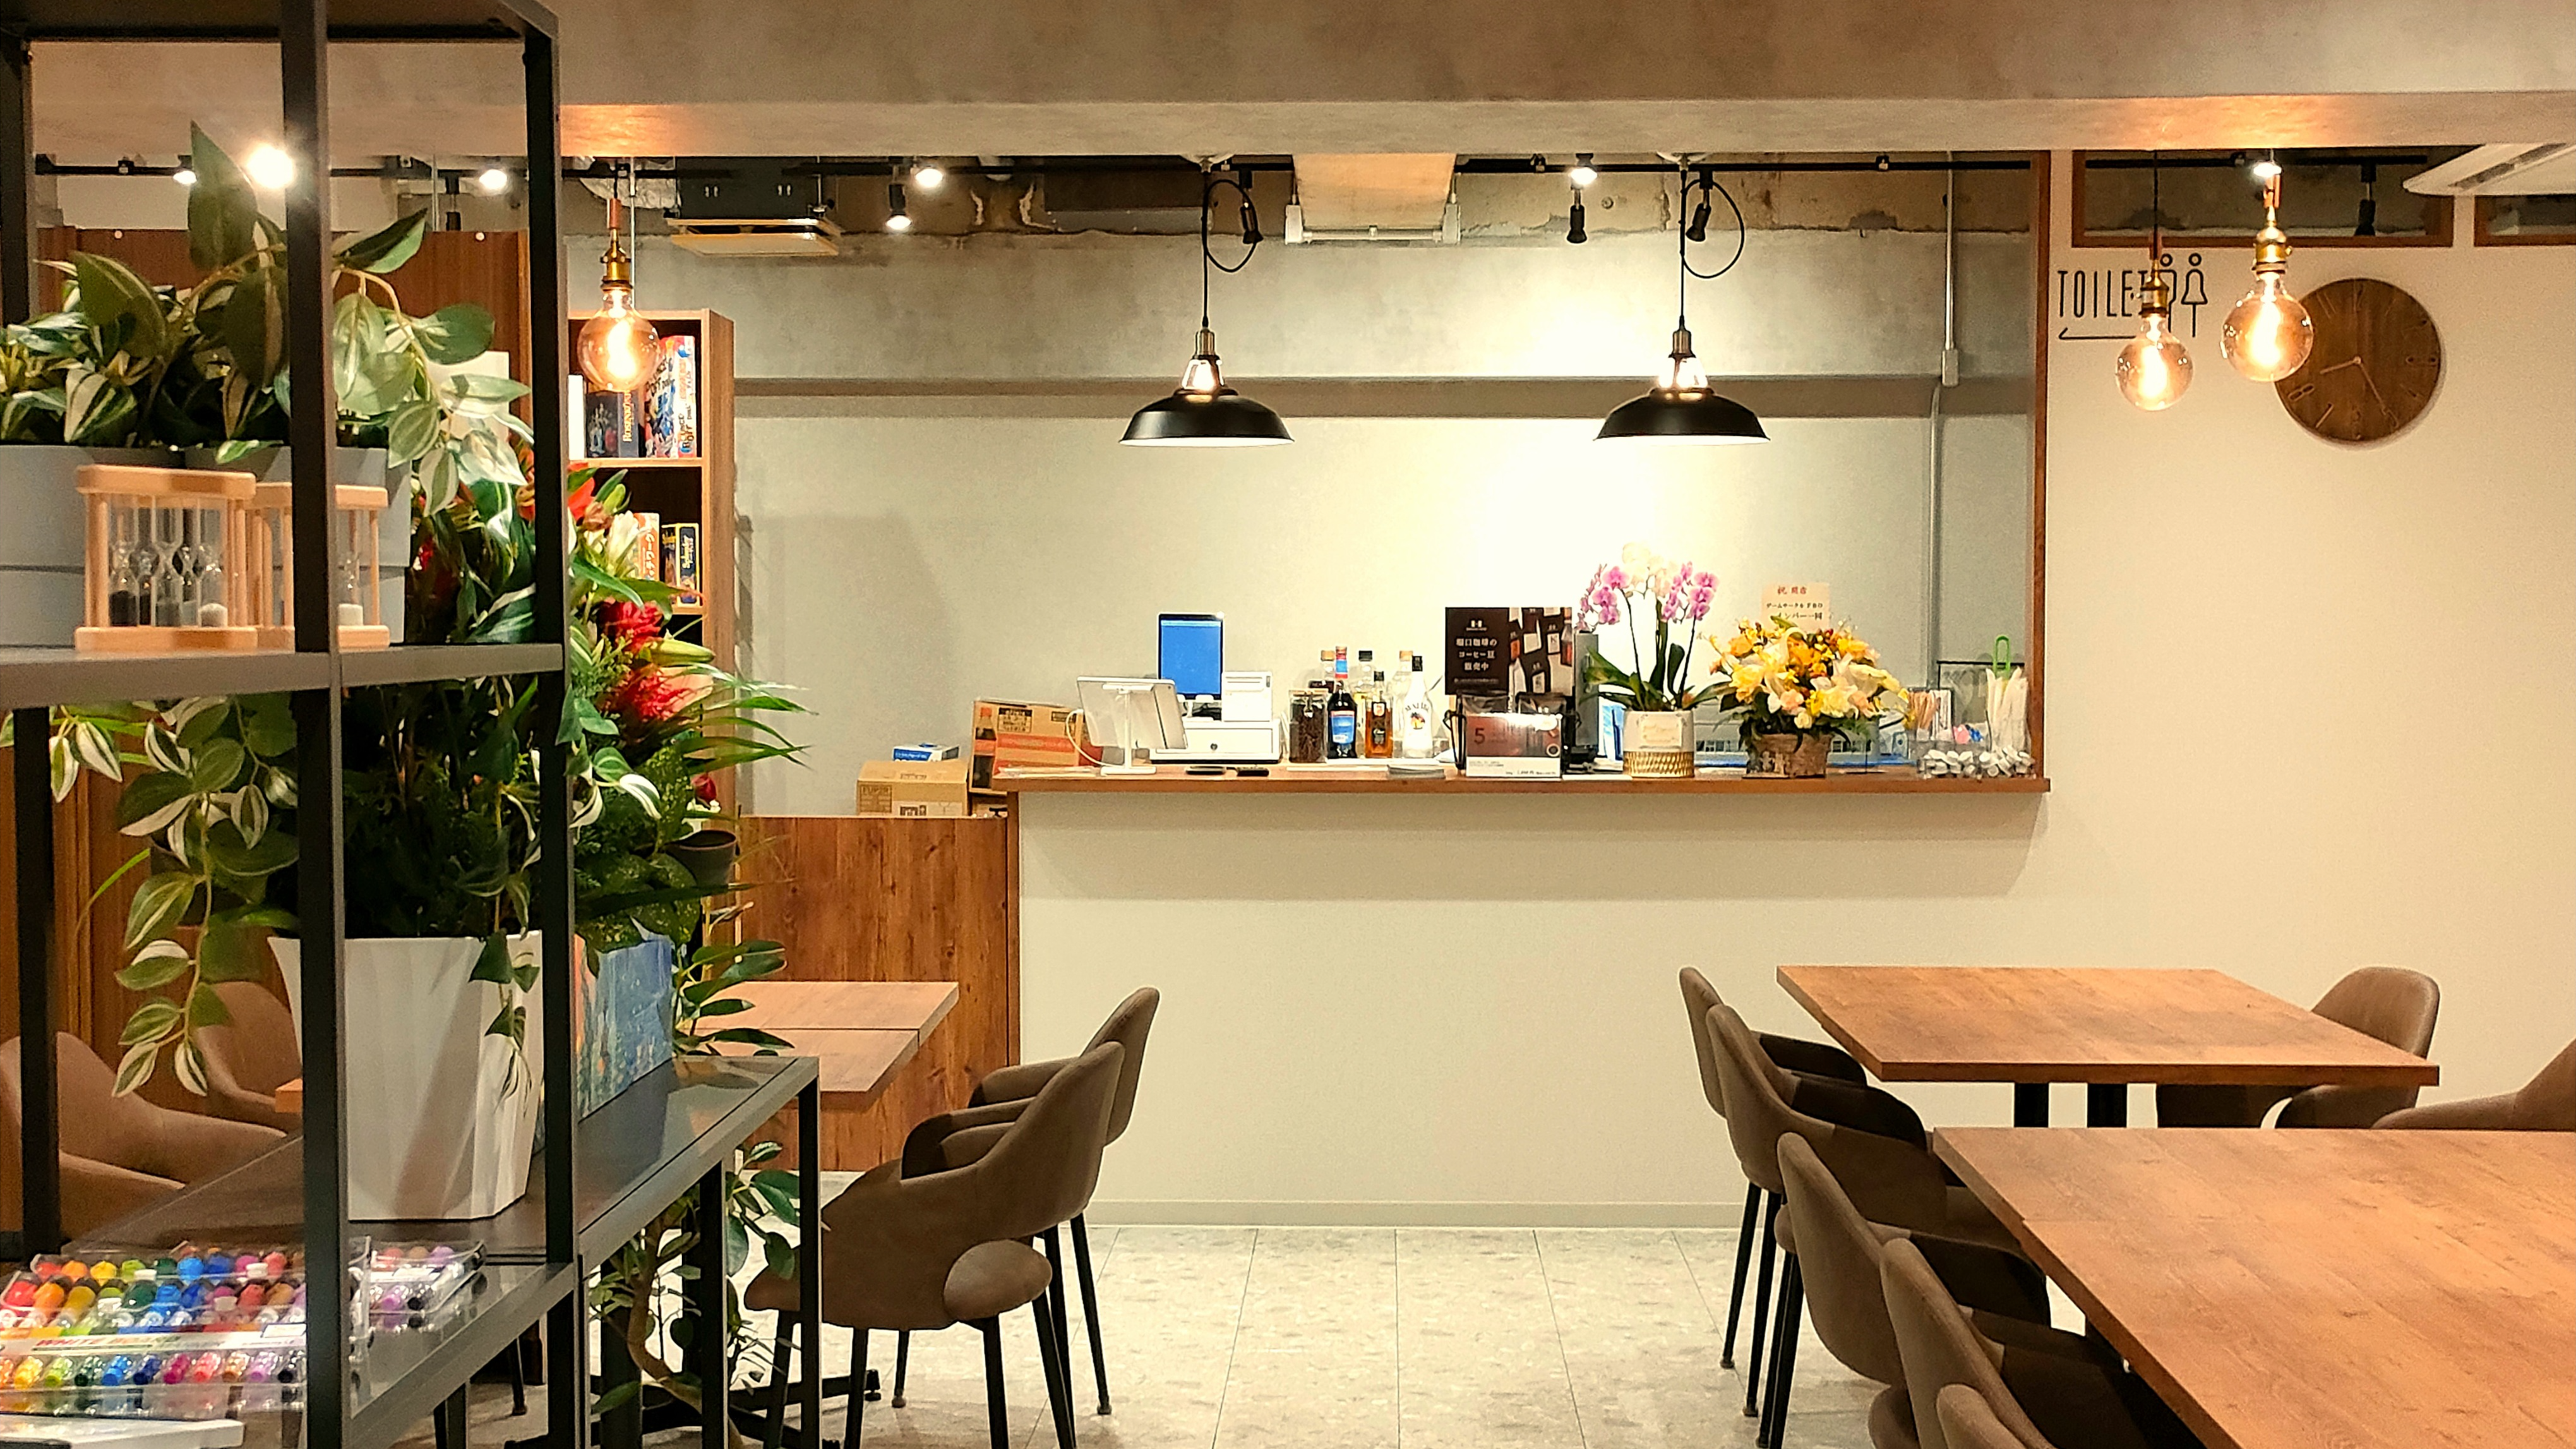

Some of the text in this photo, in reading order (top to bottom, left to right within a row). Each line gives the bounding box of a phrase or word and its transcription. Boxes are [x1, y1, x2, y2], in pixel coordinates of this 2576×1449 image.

[645, 532, 656, 580] ッチワーク
[1459, 650, 1495, 659] コーヒー豆
[1464, 661, 1490, 671] 販売中
[1473, 728, 1486, 745] 5
